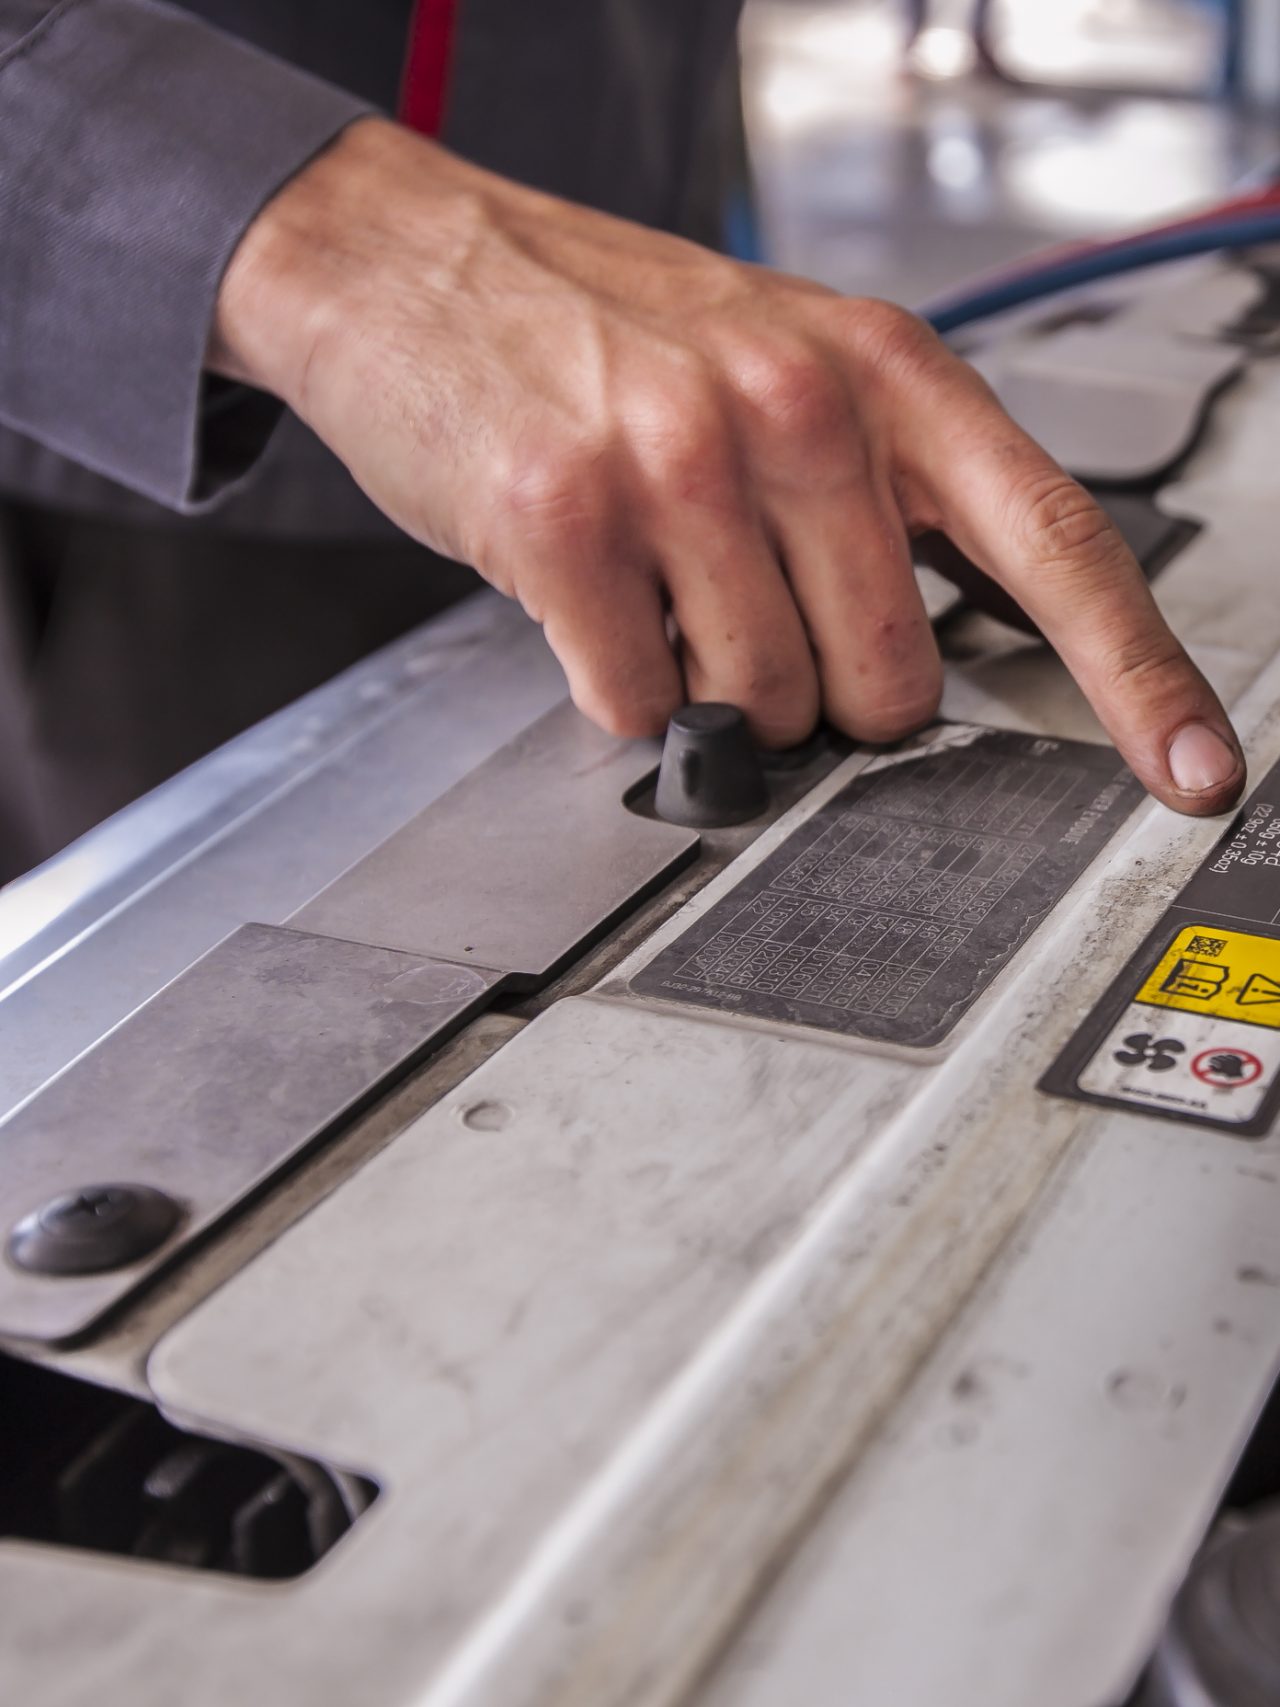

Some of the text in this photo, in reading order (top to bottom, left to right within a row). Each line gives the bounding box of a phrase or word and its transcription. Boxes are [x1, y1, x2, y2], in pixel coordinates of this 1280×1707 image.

[1208, 841, 1246, 873] 0.35oz)
[1240, 850, 1266, 865] 10g
[751, 896, 776, 914] 122
[915, 875, 960, 912] 002308
[963, 883, 1006, 921] 031850
[730, 903, 824, 985] 95 020248
[752, 907, 848, 991] 94 010310
[779, 912, 872, 996] 79 010600
[927, 945, 954, 960] 50
[941, 929, 964, 943] 45
[805, 914, 894, 1000] 64 010101
[829, 920, 916, 1005] 48 042519
[854, 923, 943, 1011] 46 026820
